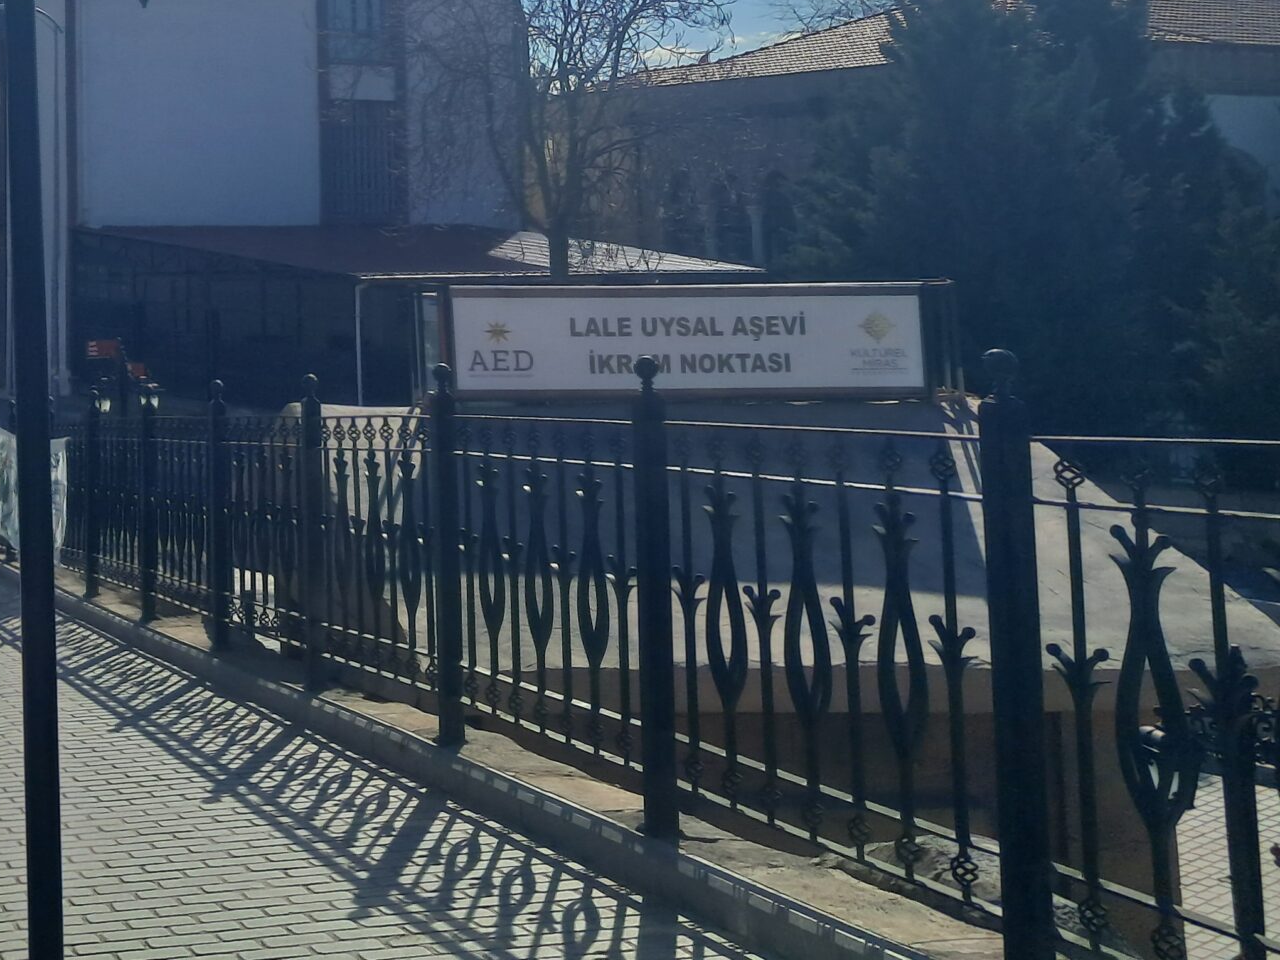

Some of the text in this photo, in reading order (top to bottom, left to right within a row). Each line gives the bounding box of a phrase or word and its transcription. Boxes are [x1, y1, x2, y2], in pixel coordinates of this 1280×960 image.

[569, 311, 807, 341] LALE UYSAL AŞEVİ
[468, 349, 534, 372] AED
[680, 353, 792, 374] NOKTASI
